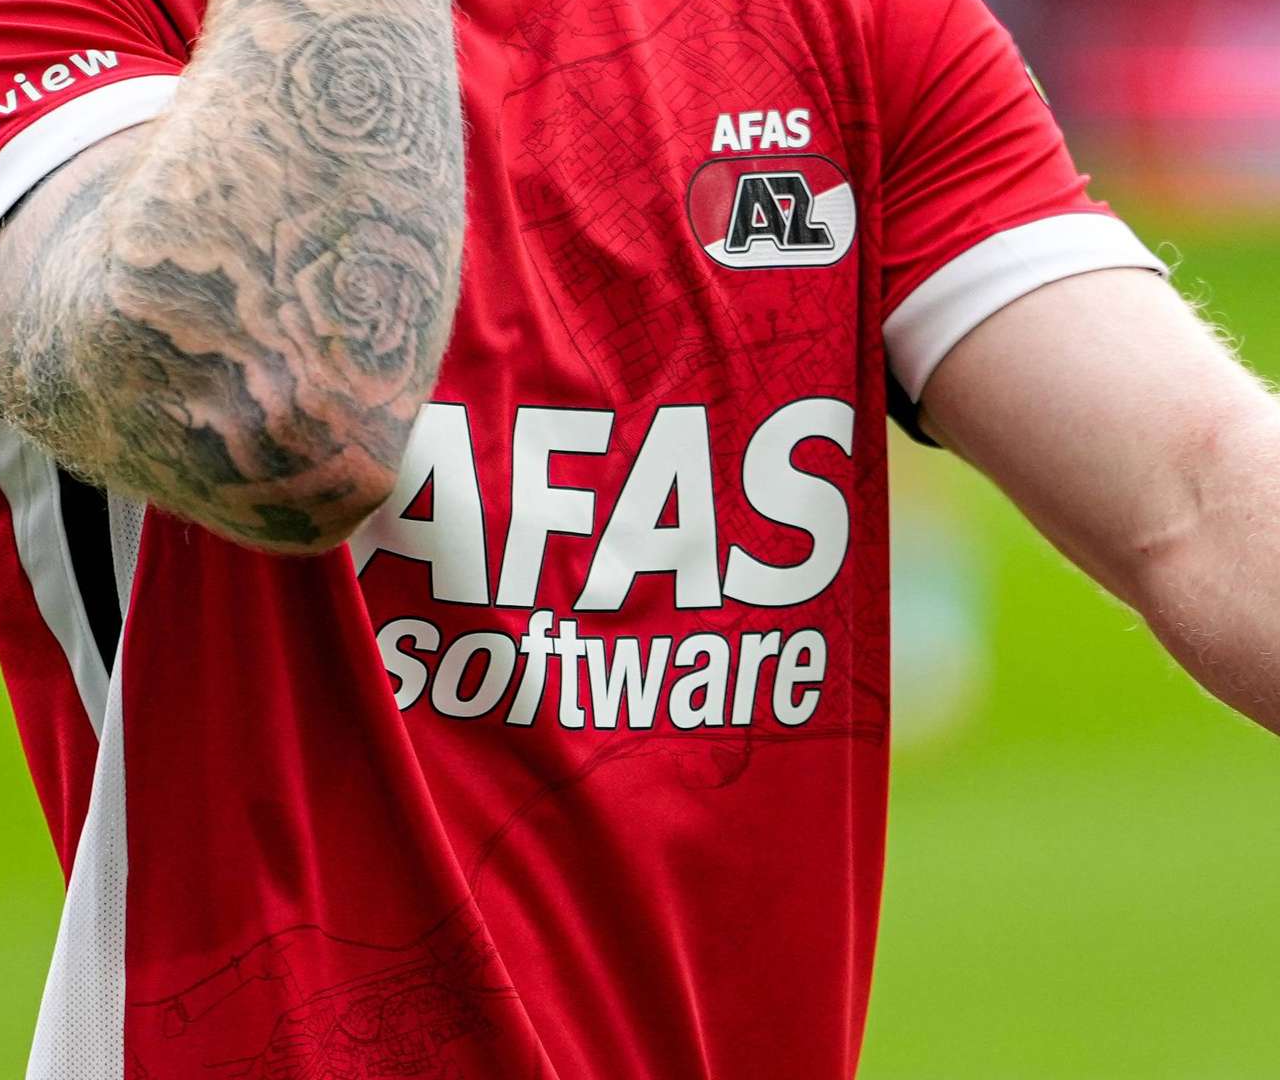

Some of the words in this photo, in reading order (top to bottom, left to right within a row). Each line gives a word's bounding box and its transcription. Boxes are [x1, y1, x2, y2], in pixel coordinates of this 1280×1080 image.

[711, 108, 811, 152] AFAS
[724, 171, 835, 254] AZ
[355, 396, 856, 611] AFAS
[376, 609, 828, 730] software
